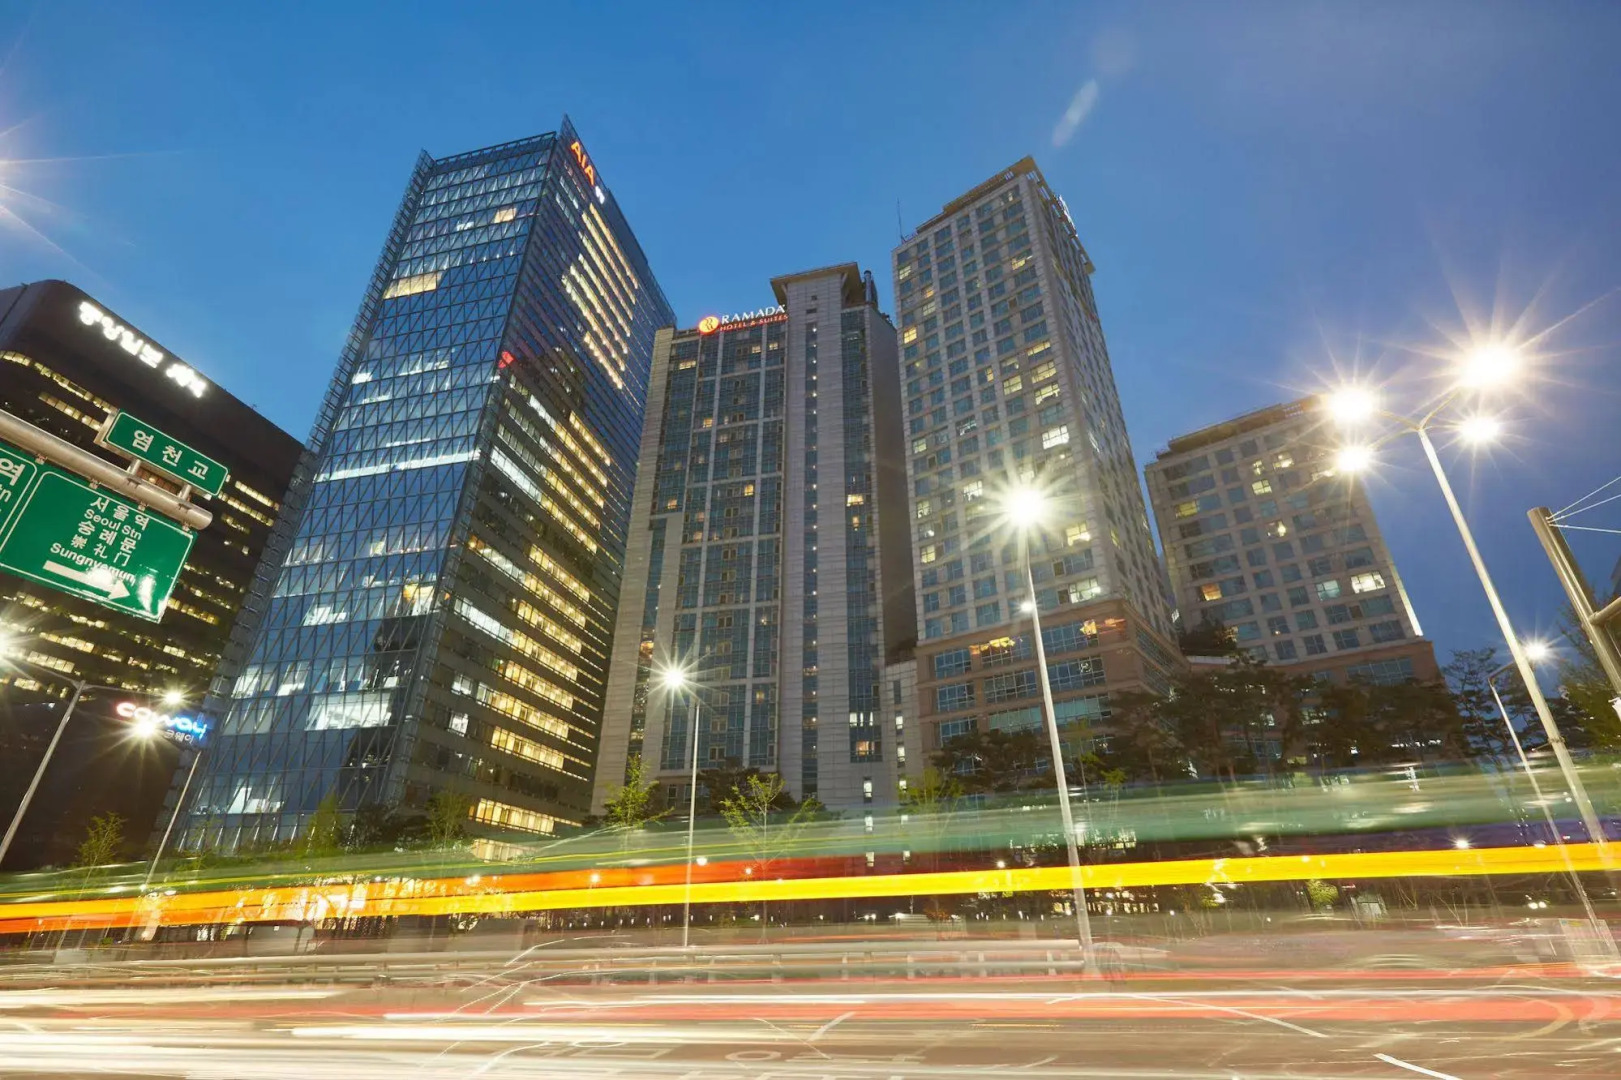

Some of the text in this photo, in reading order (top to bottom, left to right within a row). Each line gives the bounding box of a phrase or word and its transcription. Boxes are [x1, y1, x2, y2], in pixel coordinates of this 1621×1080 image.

[571, 141, 594, 186] AIA
[720, 322, 747, 332] HOTEL
[759, 314, 789, 325] SUITES
[721, 304, 785, 325] RAMADA
[132, 429, 209, 480] 염천교
[84, 509, 142, 540] Seoul Stn
[90, 497, 150, 531] 서울역
[70, 535, 130, 566] 崇礼门
[78, 520, 136, 552] 숭례문
